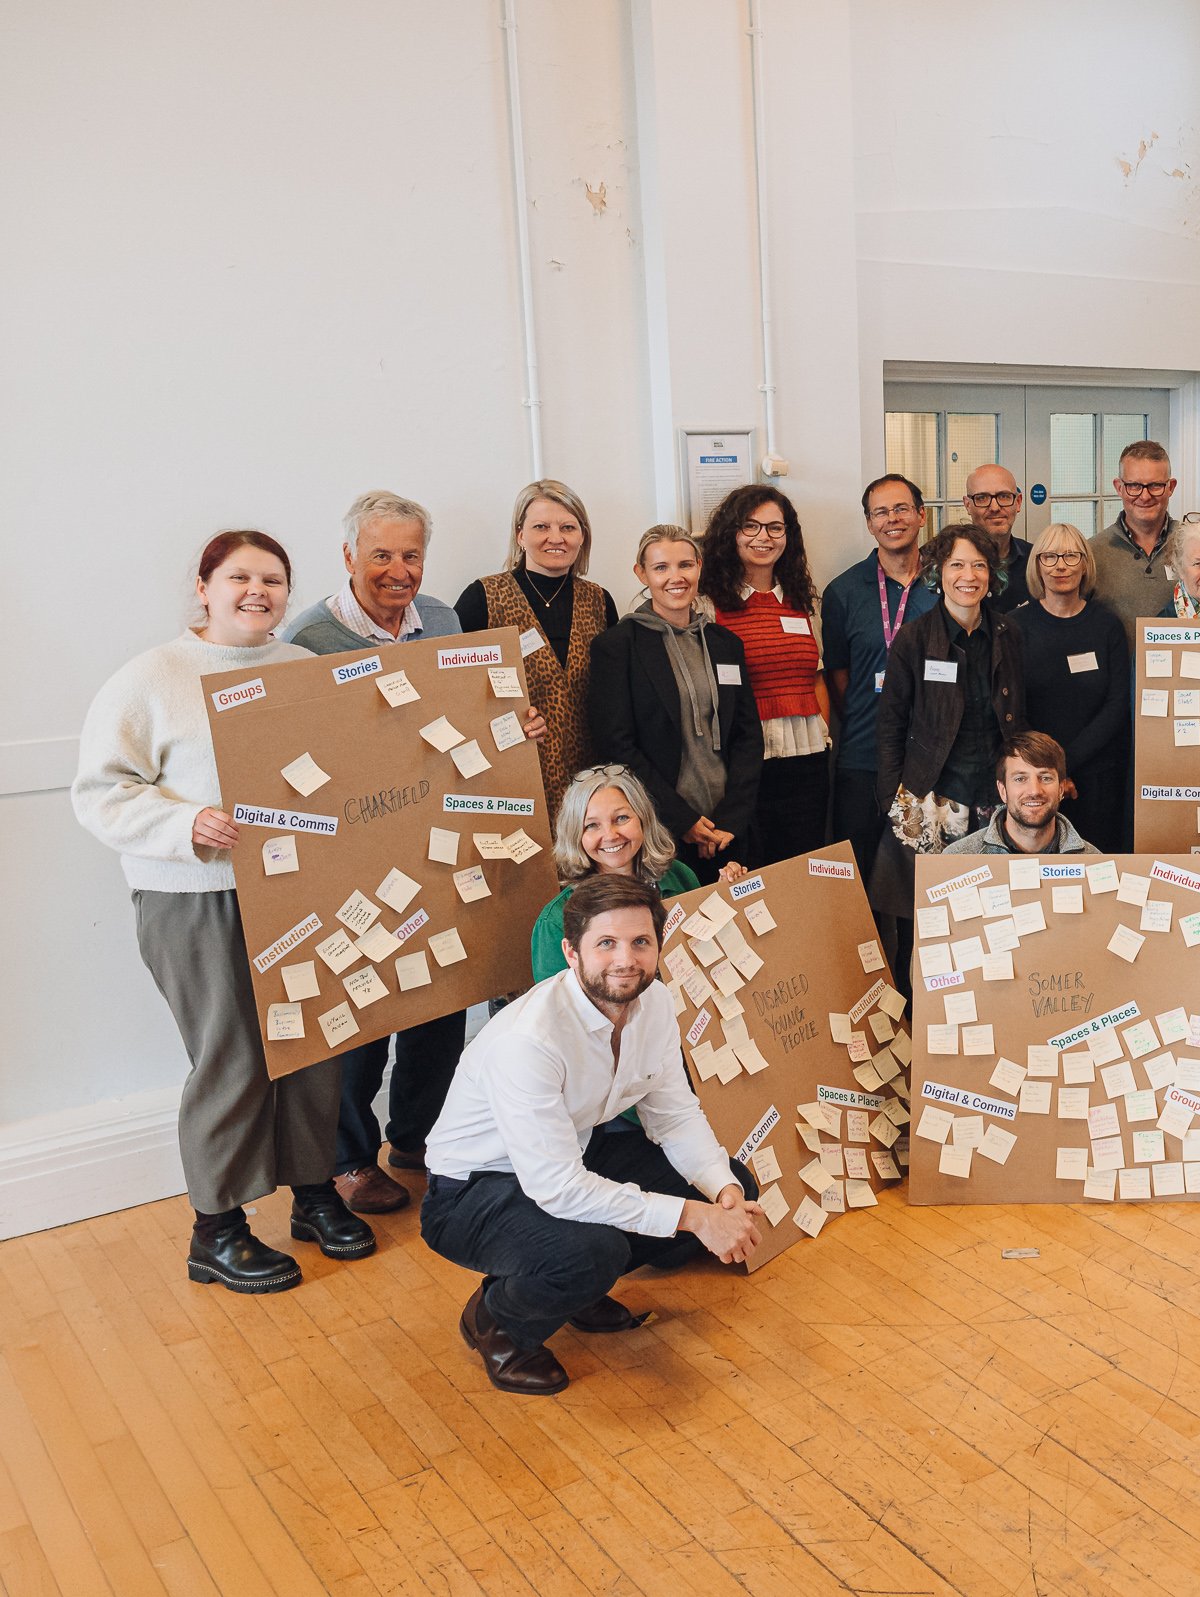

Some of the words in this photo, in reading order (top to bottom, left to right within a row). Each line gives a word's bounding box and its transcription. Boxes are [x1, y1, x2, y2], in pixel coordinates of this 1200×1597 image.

[1146, 631, 1181, 642] Spaces
[1184, 632, 1191, 640] &
[338, 661, 379, 680] Stories
[441, 651, 499, 666] Individuals
[218, 684, 263, 705] Groups
[344, 780, 430, 825] CHARFIELD
[445, 796, 484, 810] Spaces
[486, 800, 494, 810] &
[497, 800, 532, 812] Places
[1142, 788, 1173, 798] Digital
[1175, 788, 1182, 797] &
[235, 807, 275, 824] Digital
[278, 814, 286, 826] &
[290, 815, 336, 832] Comms
[810, 862, 851, 877] Individuals
[1042, 866, 1082, 877] Stories
[733, 880, 762, 897] Stories
[930, 869, 991, 899] Institutions
[396, 914, 425, 941] Other
[662, 908, 683, 937] roups
[257, 917, 319, 968] Institutions
[930, 974, 960, 989] Other
[752, 973, 809, 1017] DISABLED
[851, 982, 886, 1020] Institutions
[1032, 993, 1094, 1018] VALLEY
[690, 1013, 708, 1041] Other
[764, 1005, 807, 1041] YOUNG
[1051, 1025, 1090, 1049] Spaces
[1091, 1022, 1101, 1032] &
[1101, 1005, 1137, 1028] Places
[780, 1020, 820, 1054] PEOPLE
[819, 1087, 848, 1102] Spaces
[849, 1093, 856, 1102] &
[923, 1084, 960, 1103] Digital
[961, 1095, 970, 1106] &
[972, 1097, 1014, 1118] Comms
[745, 1142, 754, 1152] &
[751, 1110, 778, 1143] Comms
